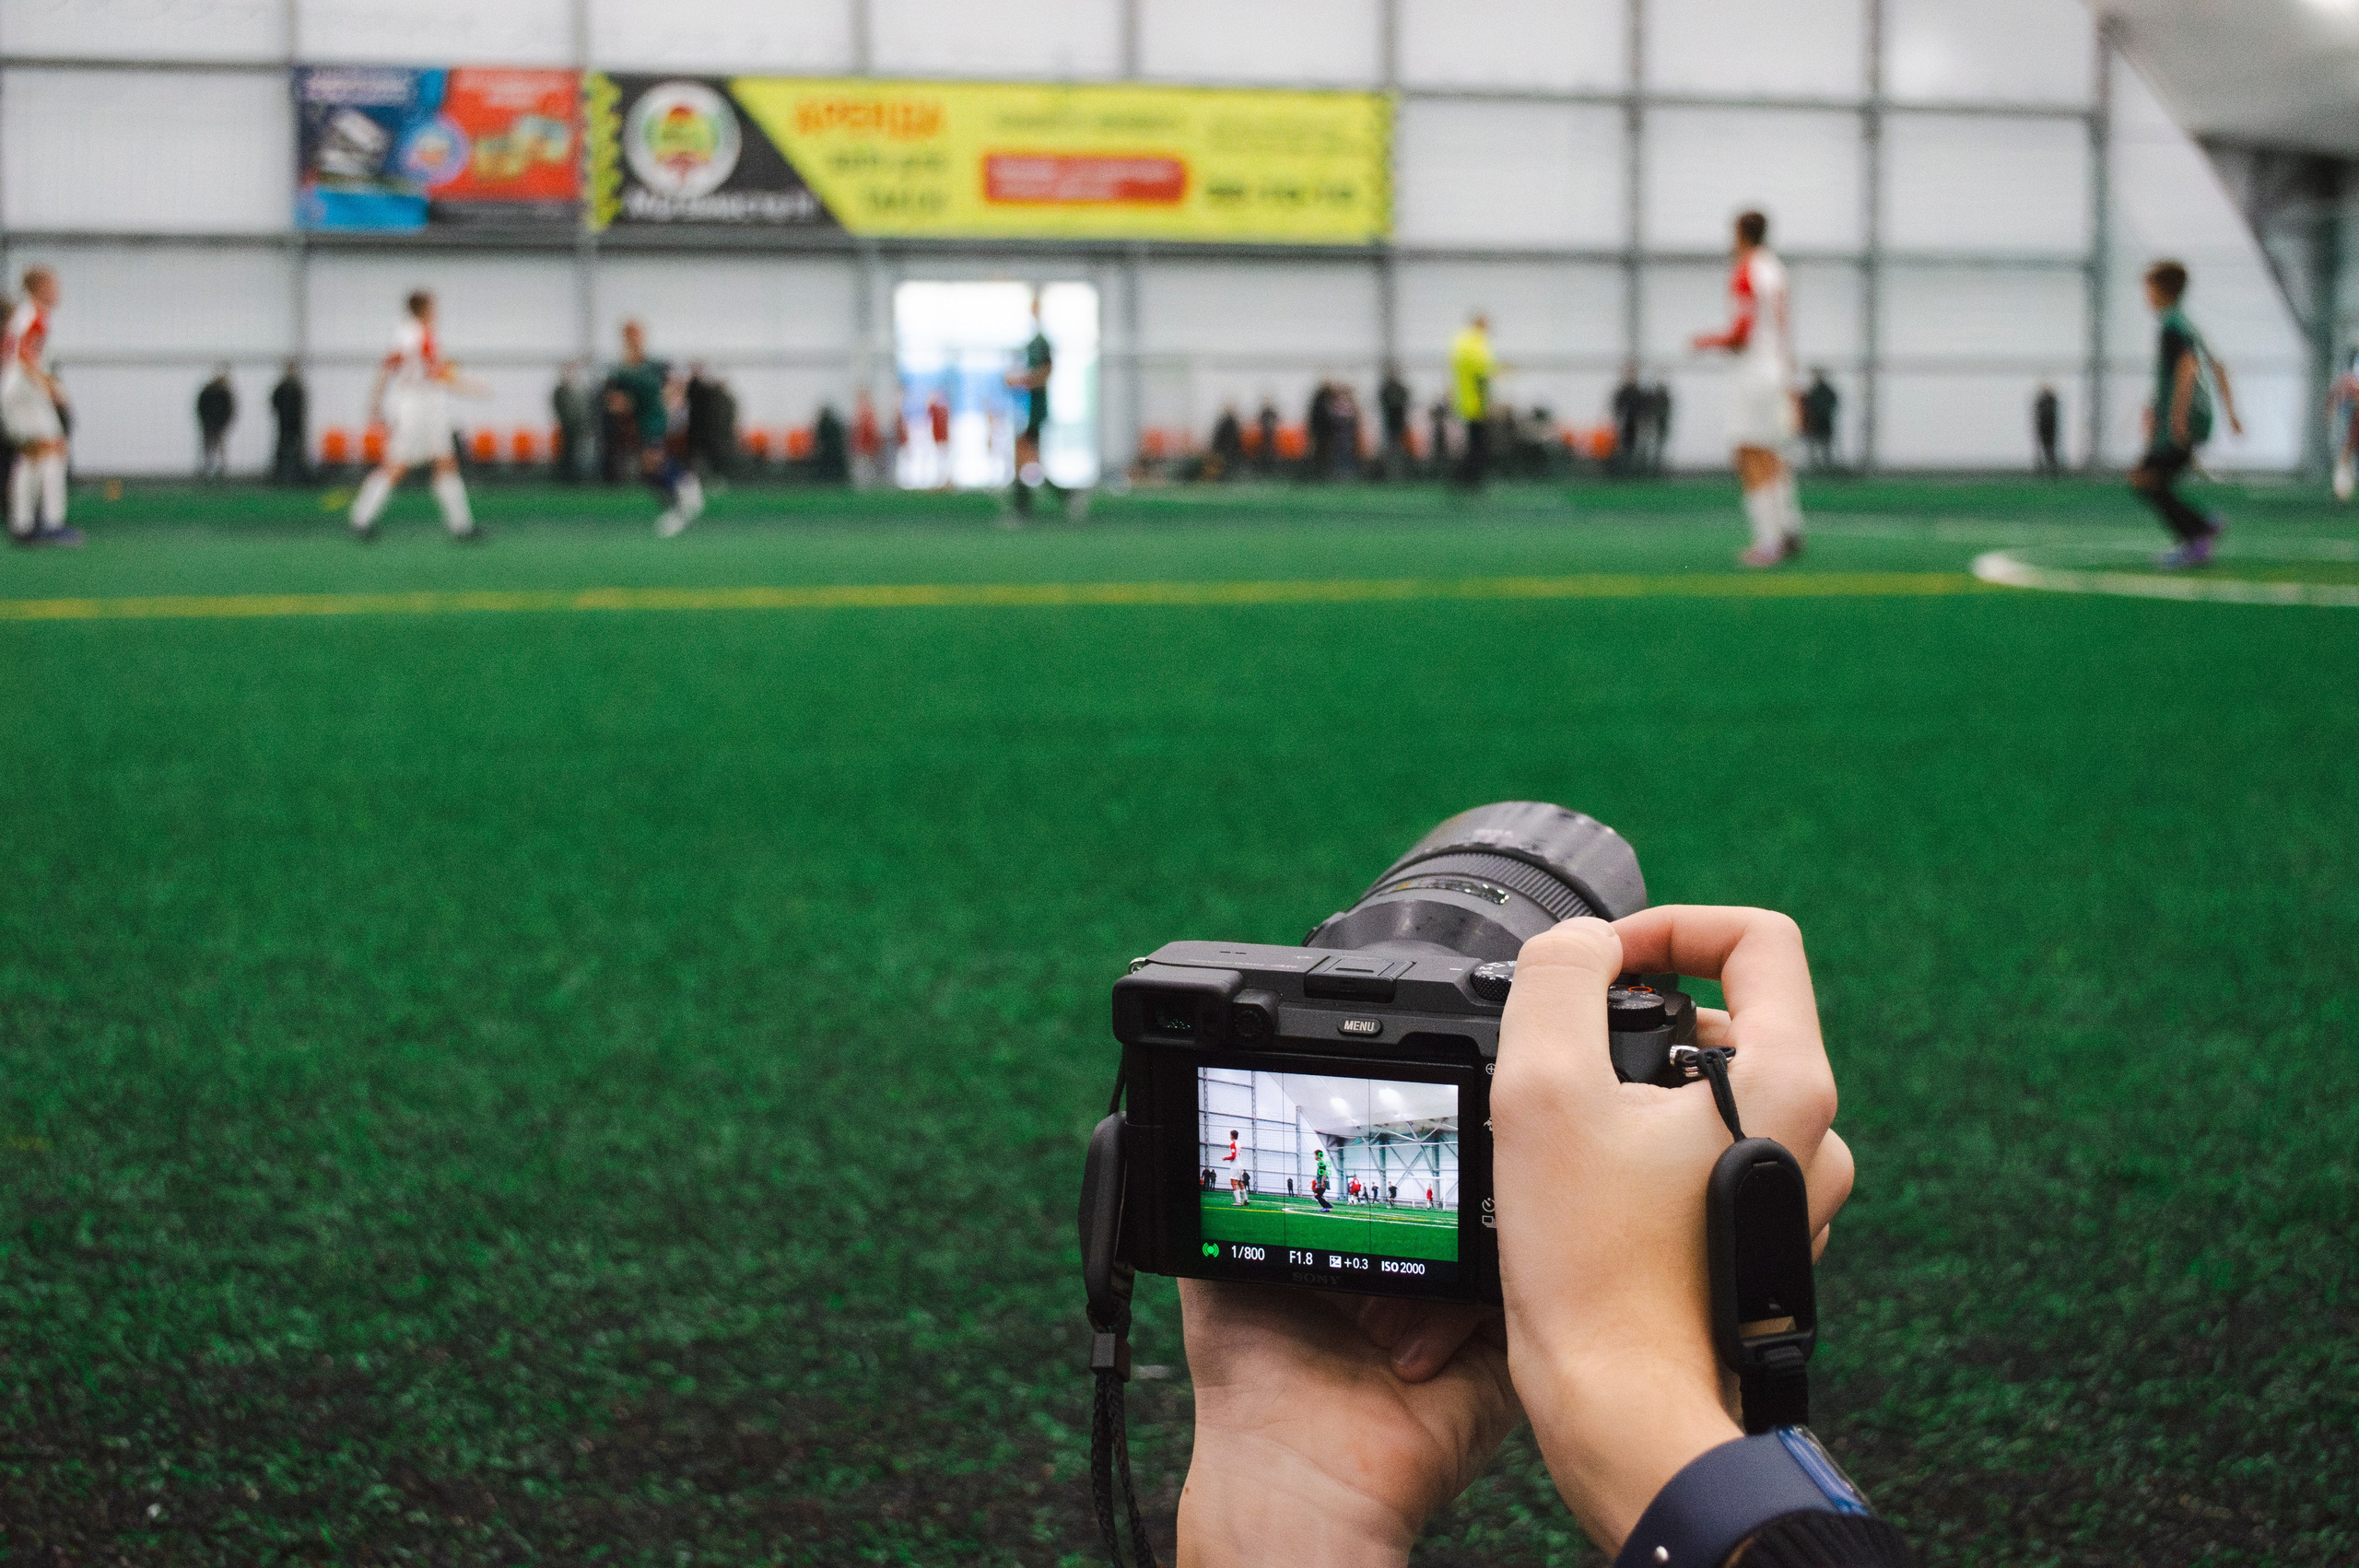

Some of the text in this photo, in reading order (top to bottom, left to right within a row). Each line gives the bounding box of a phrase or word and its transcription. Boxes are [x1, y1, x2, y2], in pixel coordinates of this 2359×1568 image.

[1344, 1020, 1375, 1032] MENU
[1231, 1245, 1426, 1275] 1/800 F1.8 +0.3 ISO 2000
[1292, 1272, 1342, 1285] SONY
